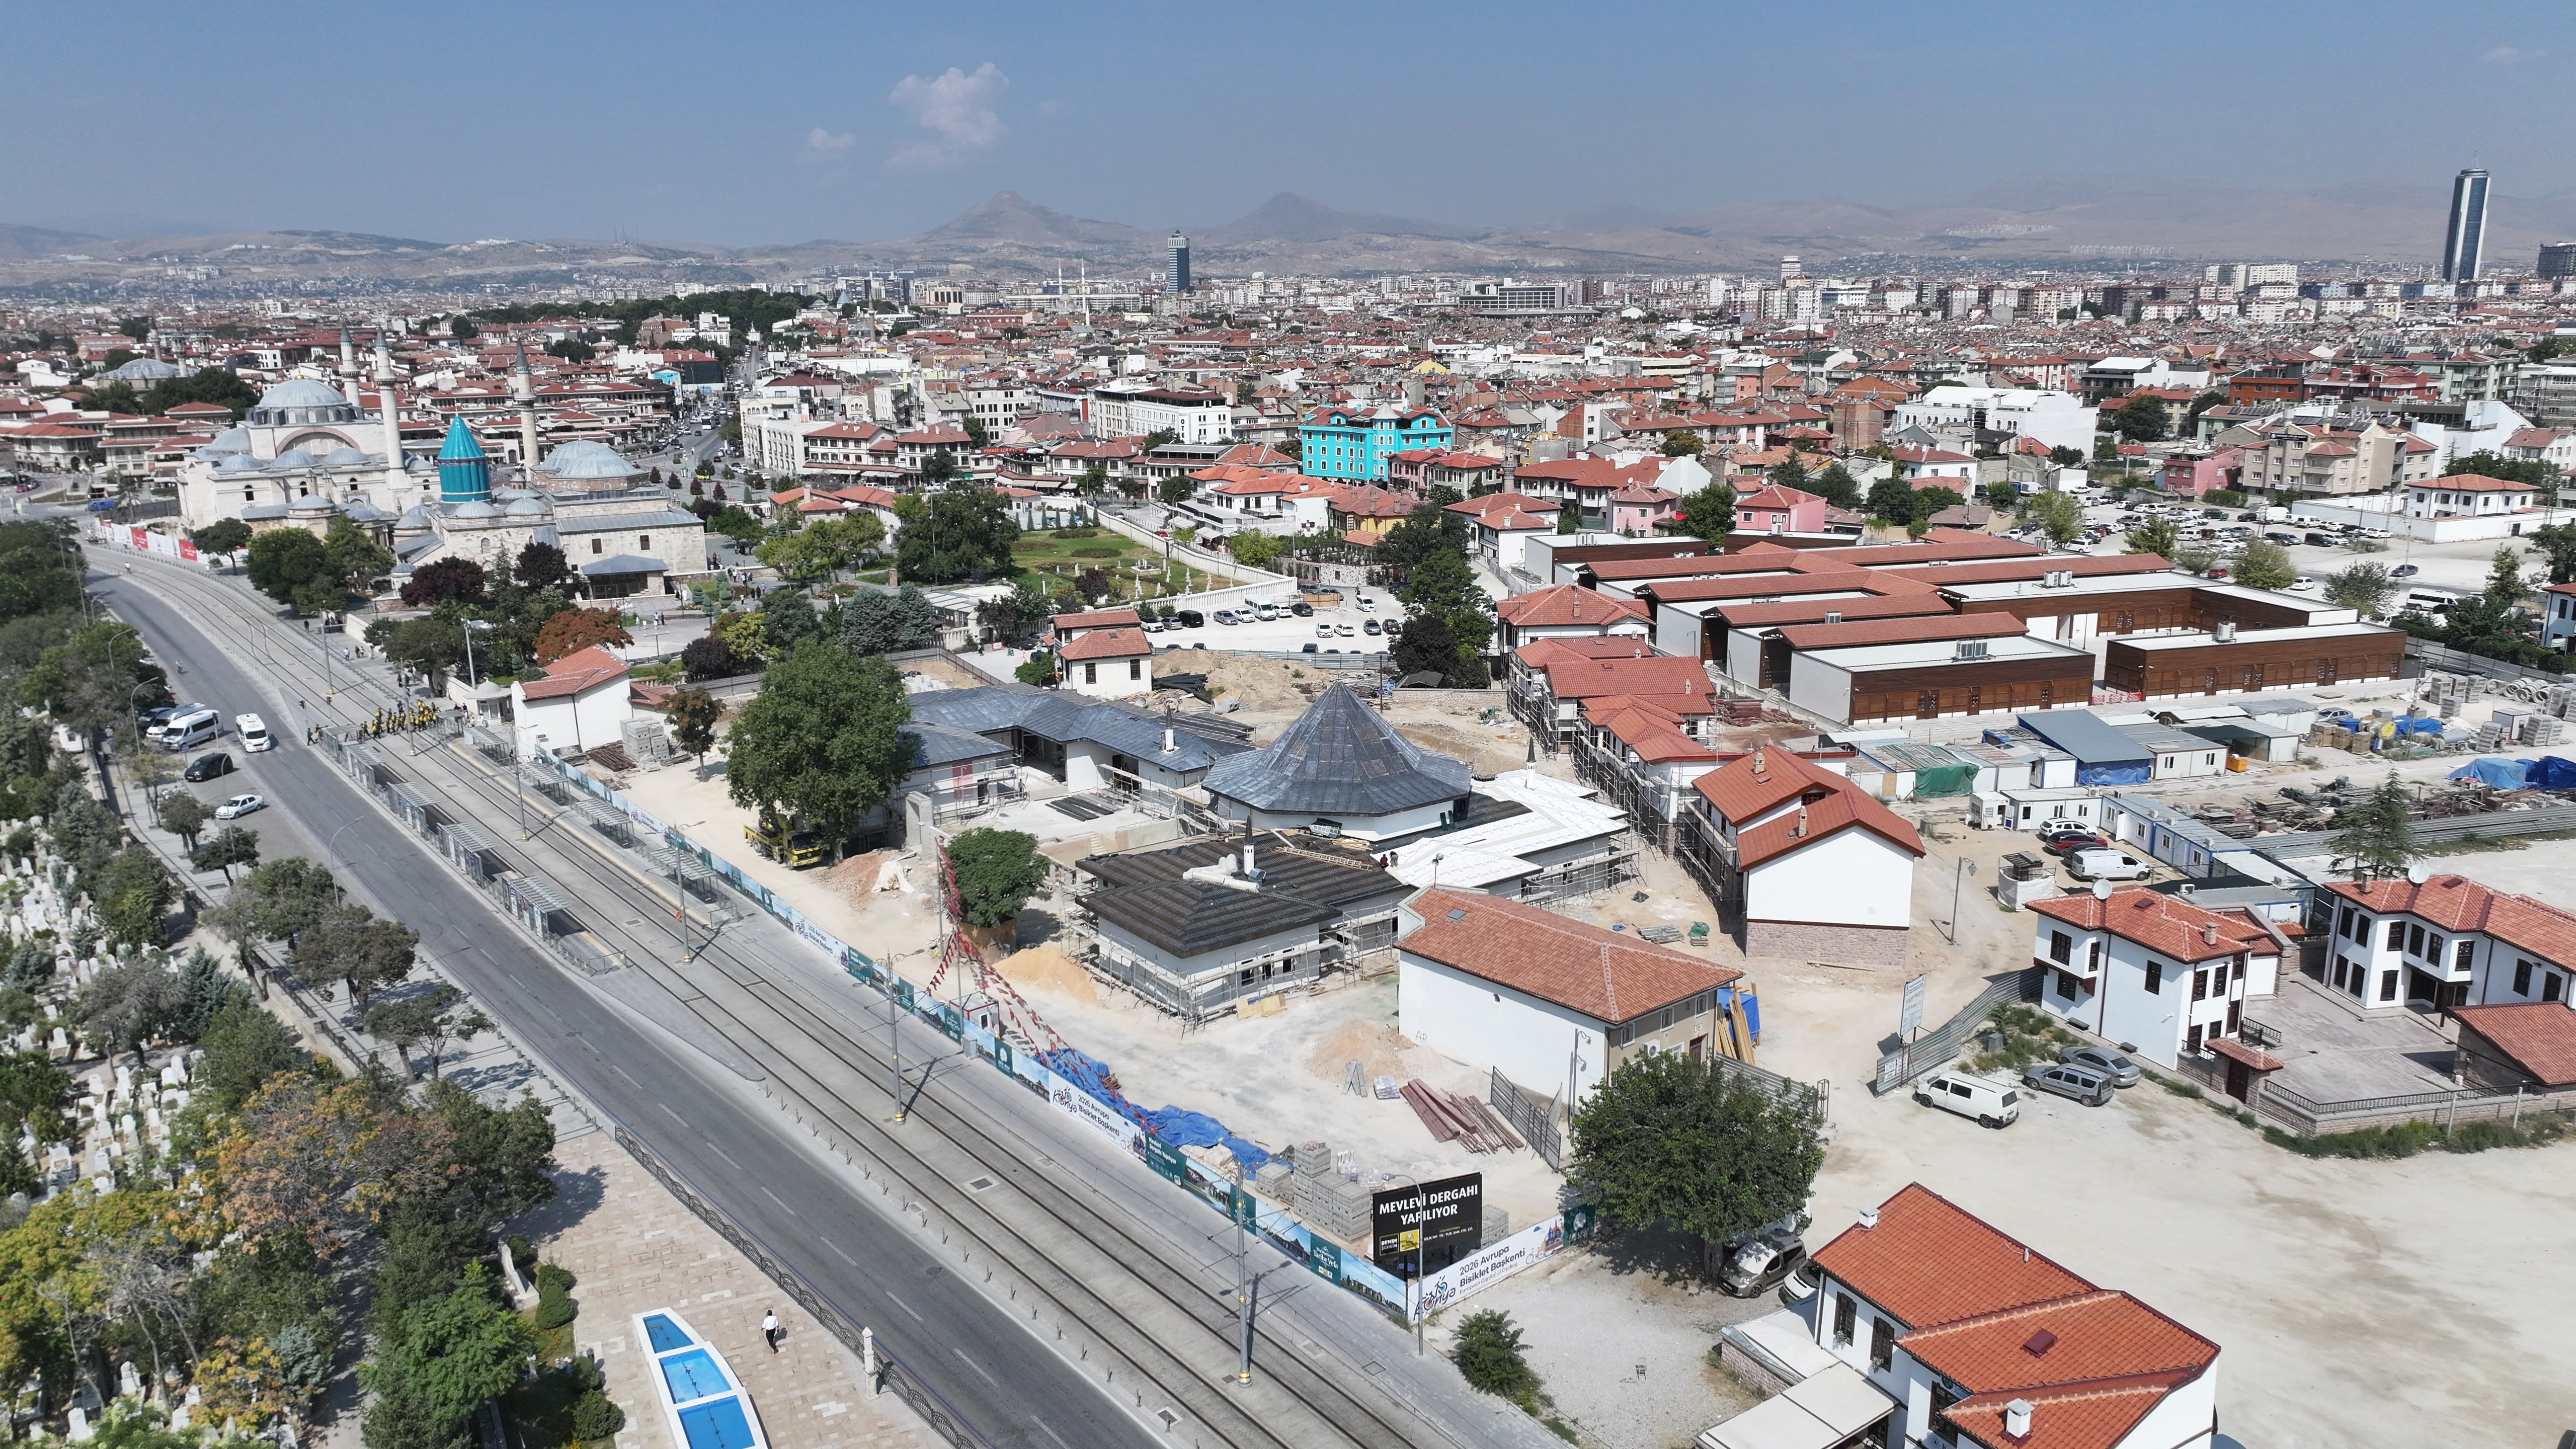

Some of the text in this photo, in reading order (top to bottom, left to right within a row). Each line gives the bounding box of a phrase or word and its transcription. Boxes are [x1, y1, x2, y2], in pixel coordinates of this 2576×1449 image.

[1078, 1104, 1119, 1137] Bisiklet Başkenti
[1091, 1103, 1109, 1119] Avrupa
[1380, 1184, 1478, 1215] MEVLEVİ DERGAHI
[1401, 1204, 1458, 1225] YAPILIYOR
[1382, 1238, 1397, 1246] BENİM
[1328, 1258, 1338, 1269] Vefa
[1460, 1246, 1509, 1276] 2026 Avrupa
[1460, 1248, 1525, 1287] Bisiklet Başkenti
[1460, 1281, 1480, 1295] European
[1481, 1272, 1497, 1284] Capital
[1502, 1262, 1518, 1273] Cycling
